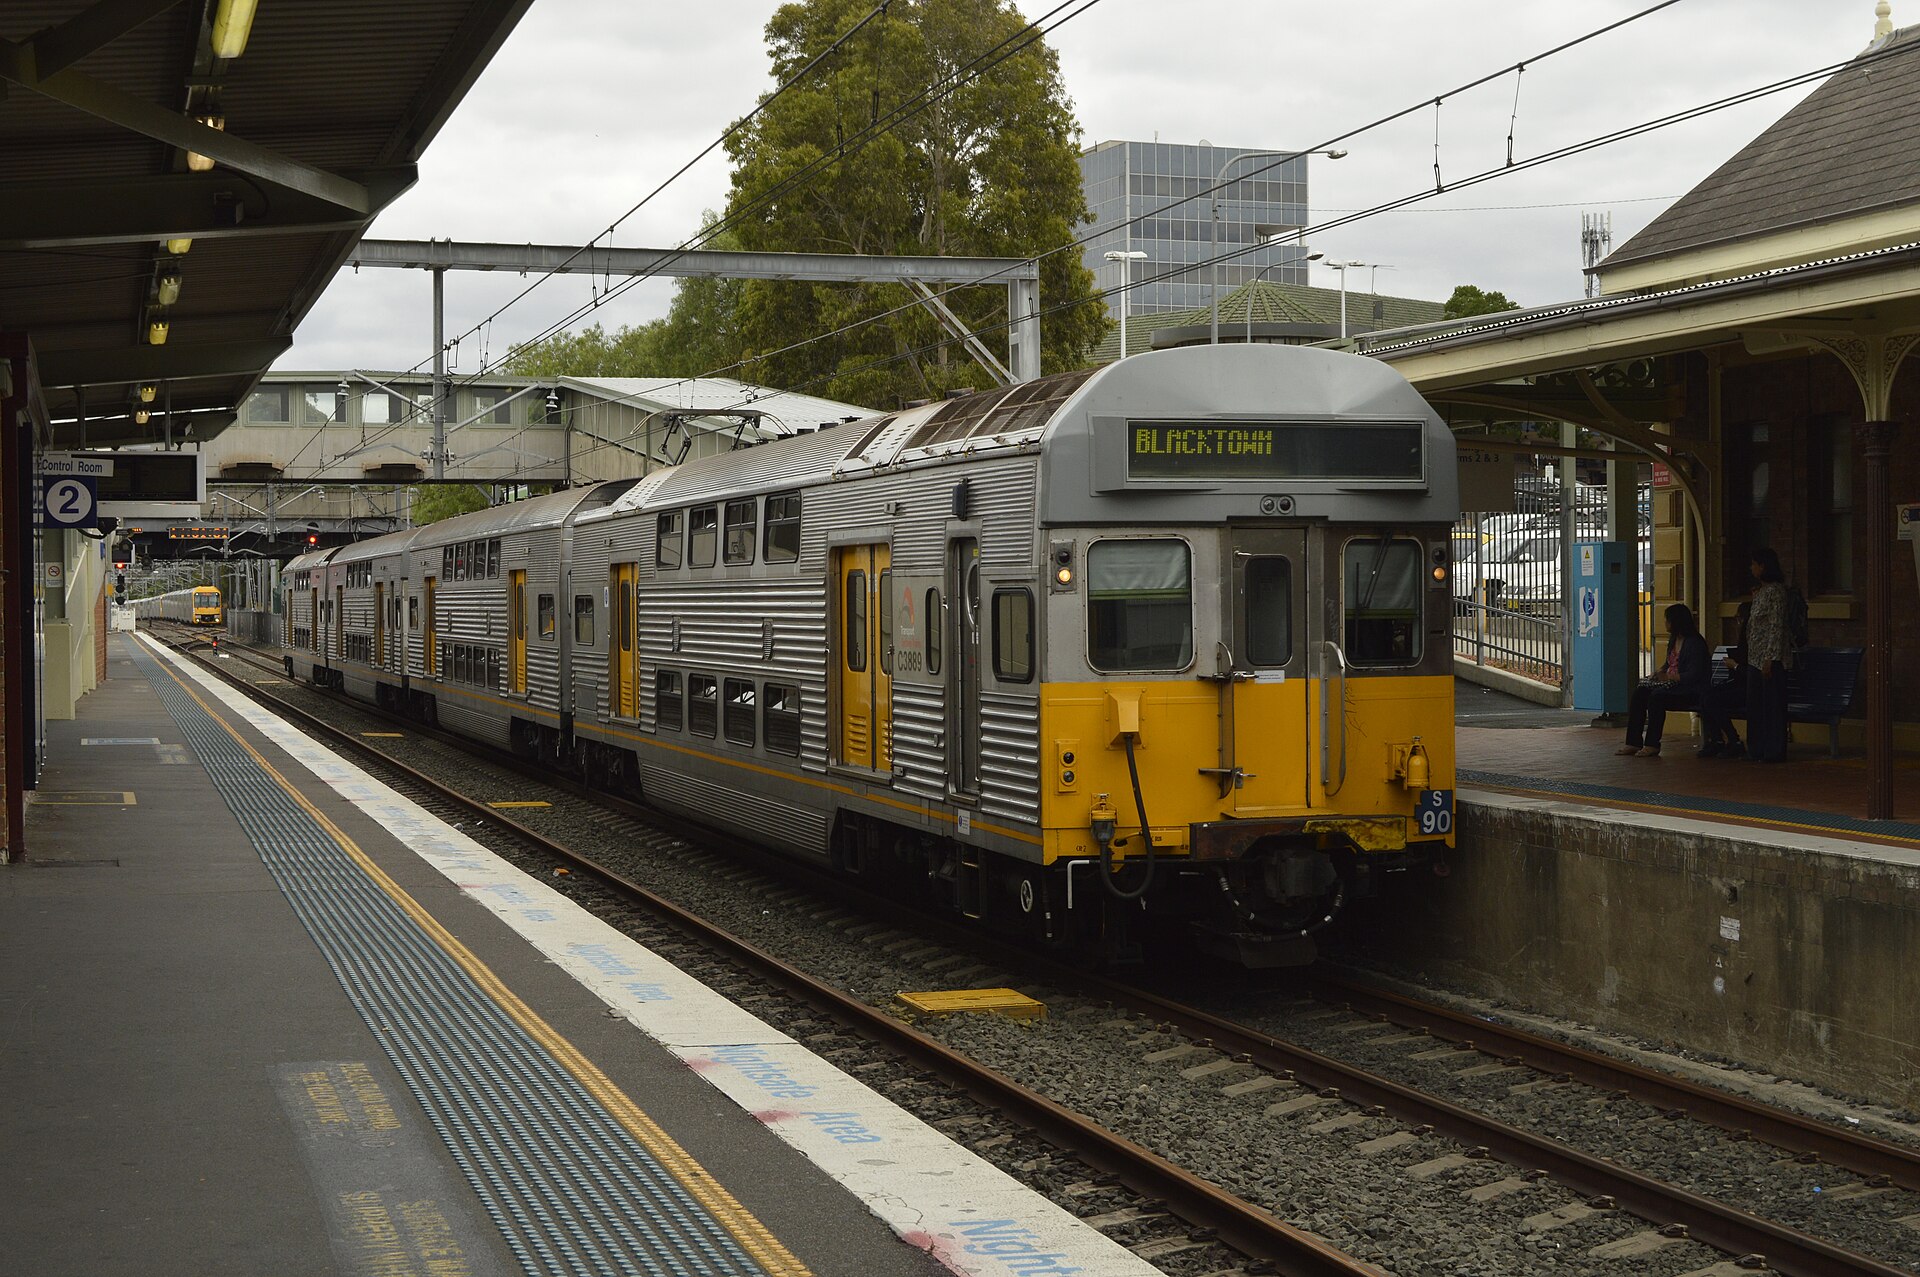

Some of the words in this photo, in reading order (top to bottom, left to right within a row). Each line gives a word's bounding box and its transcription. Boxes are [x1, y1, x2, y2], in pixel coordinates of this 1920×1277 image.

[1136, 429, 1272, 454] BLACKTOWN
[42, 459, 73, 472] Control
[78, 461, 103, 473] Room
[1475, 453, 1481, 463] 2
[1484, 453, 1491, 463] &
[1494, 453, 1499, 463] 3
[59, 485, 79, 514] 2
[897, 650, 922, 672] C3889
[1432, 790, 1443, 807] S
[1423, 810, 1451, 833] 90
[711, 1043, 820, 1099] Nightsafe
[800, 1111, 882, 1145] Area
